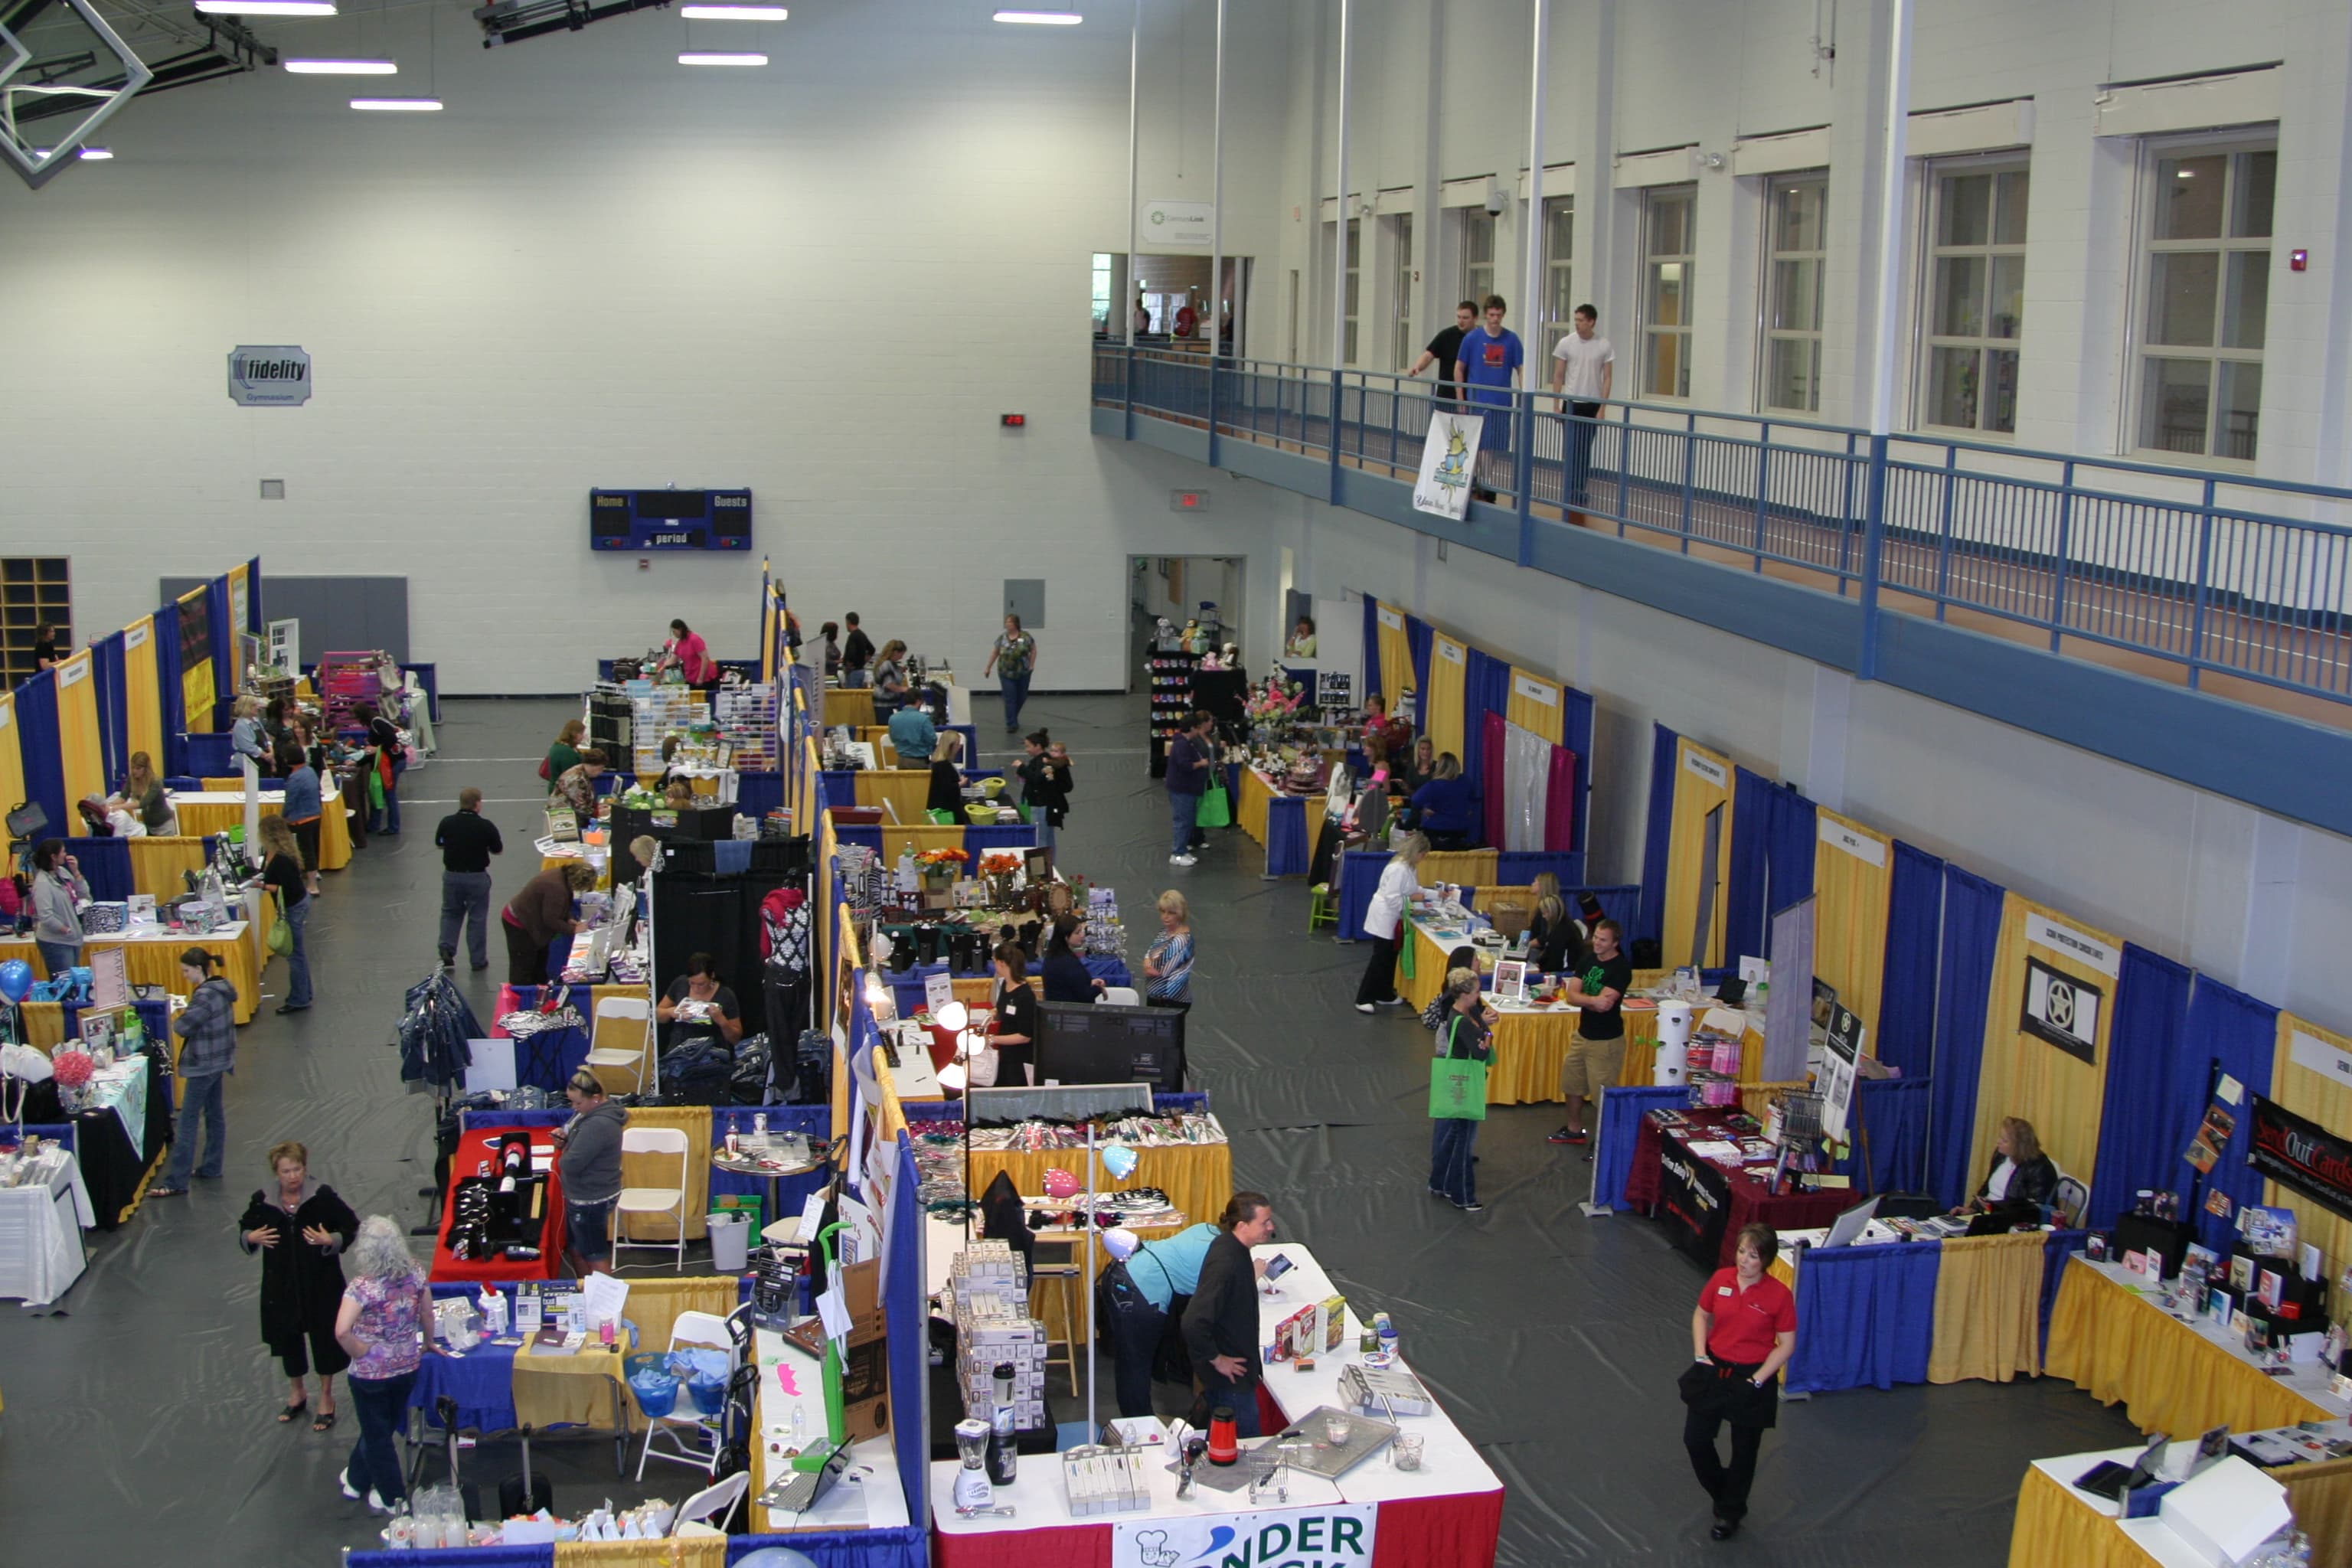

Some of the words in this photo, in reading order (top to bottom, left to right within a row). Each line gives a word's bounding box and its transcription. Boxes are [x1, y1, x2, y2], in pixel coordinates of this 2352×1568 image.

[248, 359, 305, 381] fidelity
[246, 394, 295, 402] Gymnasium
[596, 496, 624, 507] Home
[714, 495, 747, 507] Guests
[656, 533, 688, 544] period
